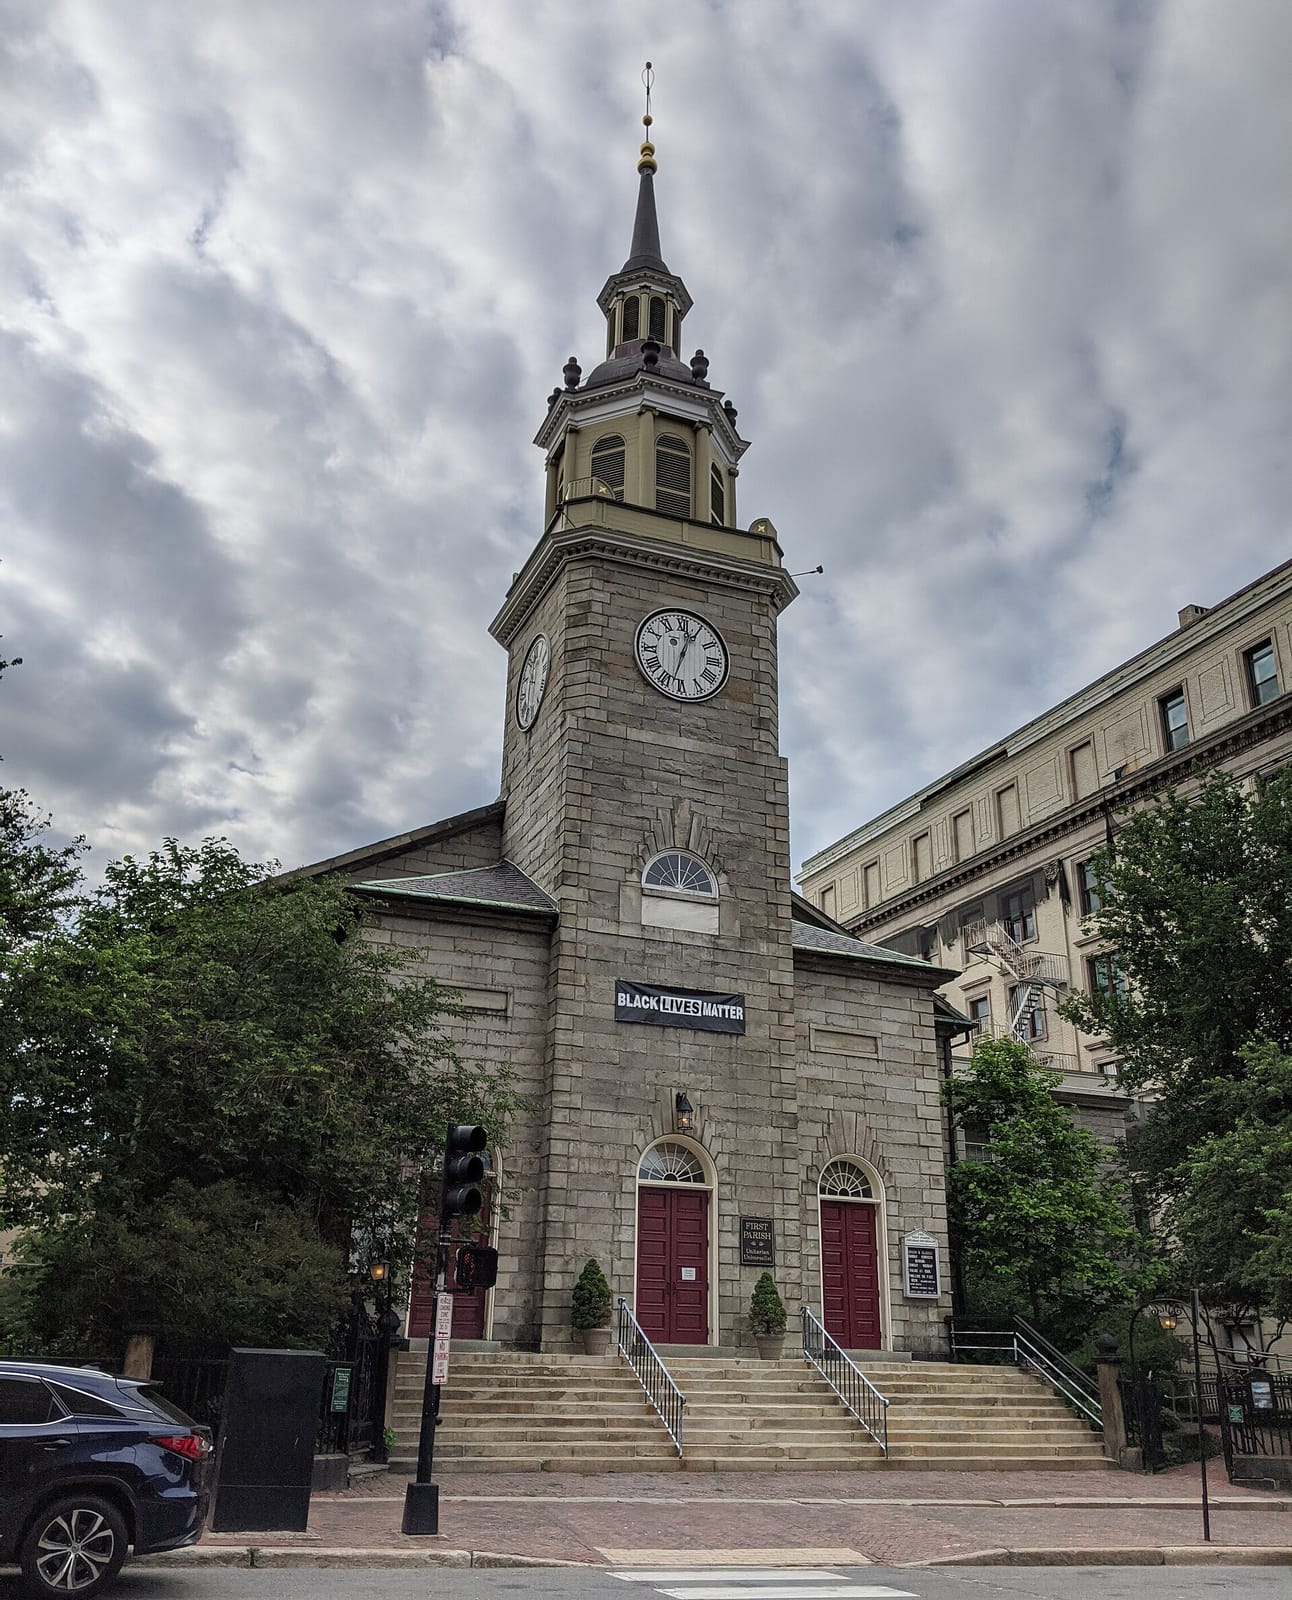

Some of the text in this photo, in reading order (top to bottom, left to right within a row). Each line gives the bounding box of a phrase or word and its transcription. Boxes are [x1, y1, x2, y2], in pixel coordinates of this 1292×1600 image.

[647, 627, 662, 640] X
[702, 641, 717, 650] II
[706, 656, 720, 667] III
[617, 992, 743, 1020] BLACK LIVES MATTER
[745, 1222, 769, 1230] FIRST
[743, 1231, 771, 1240] PARISH
